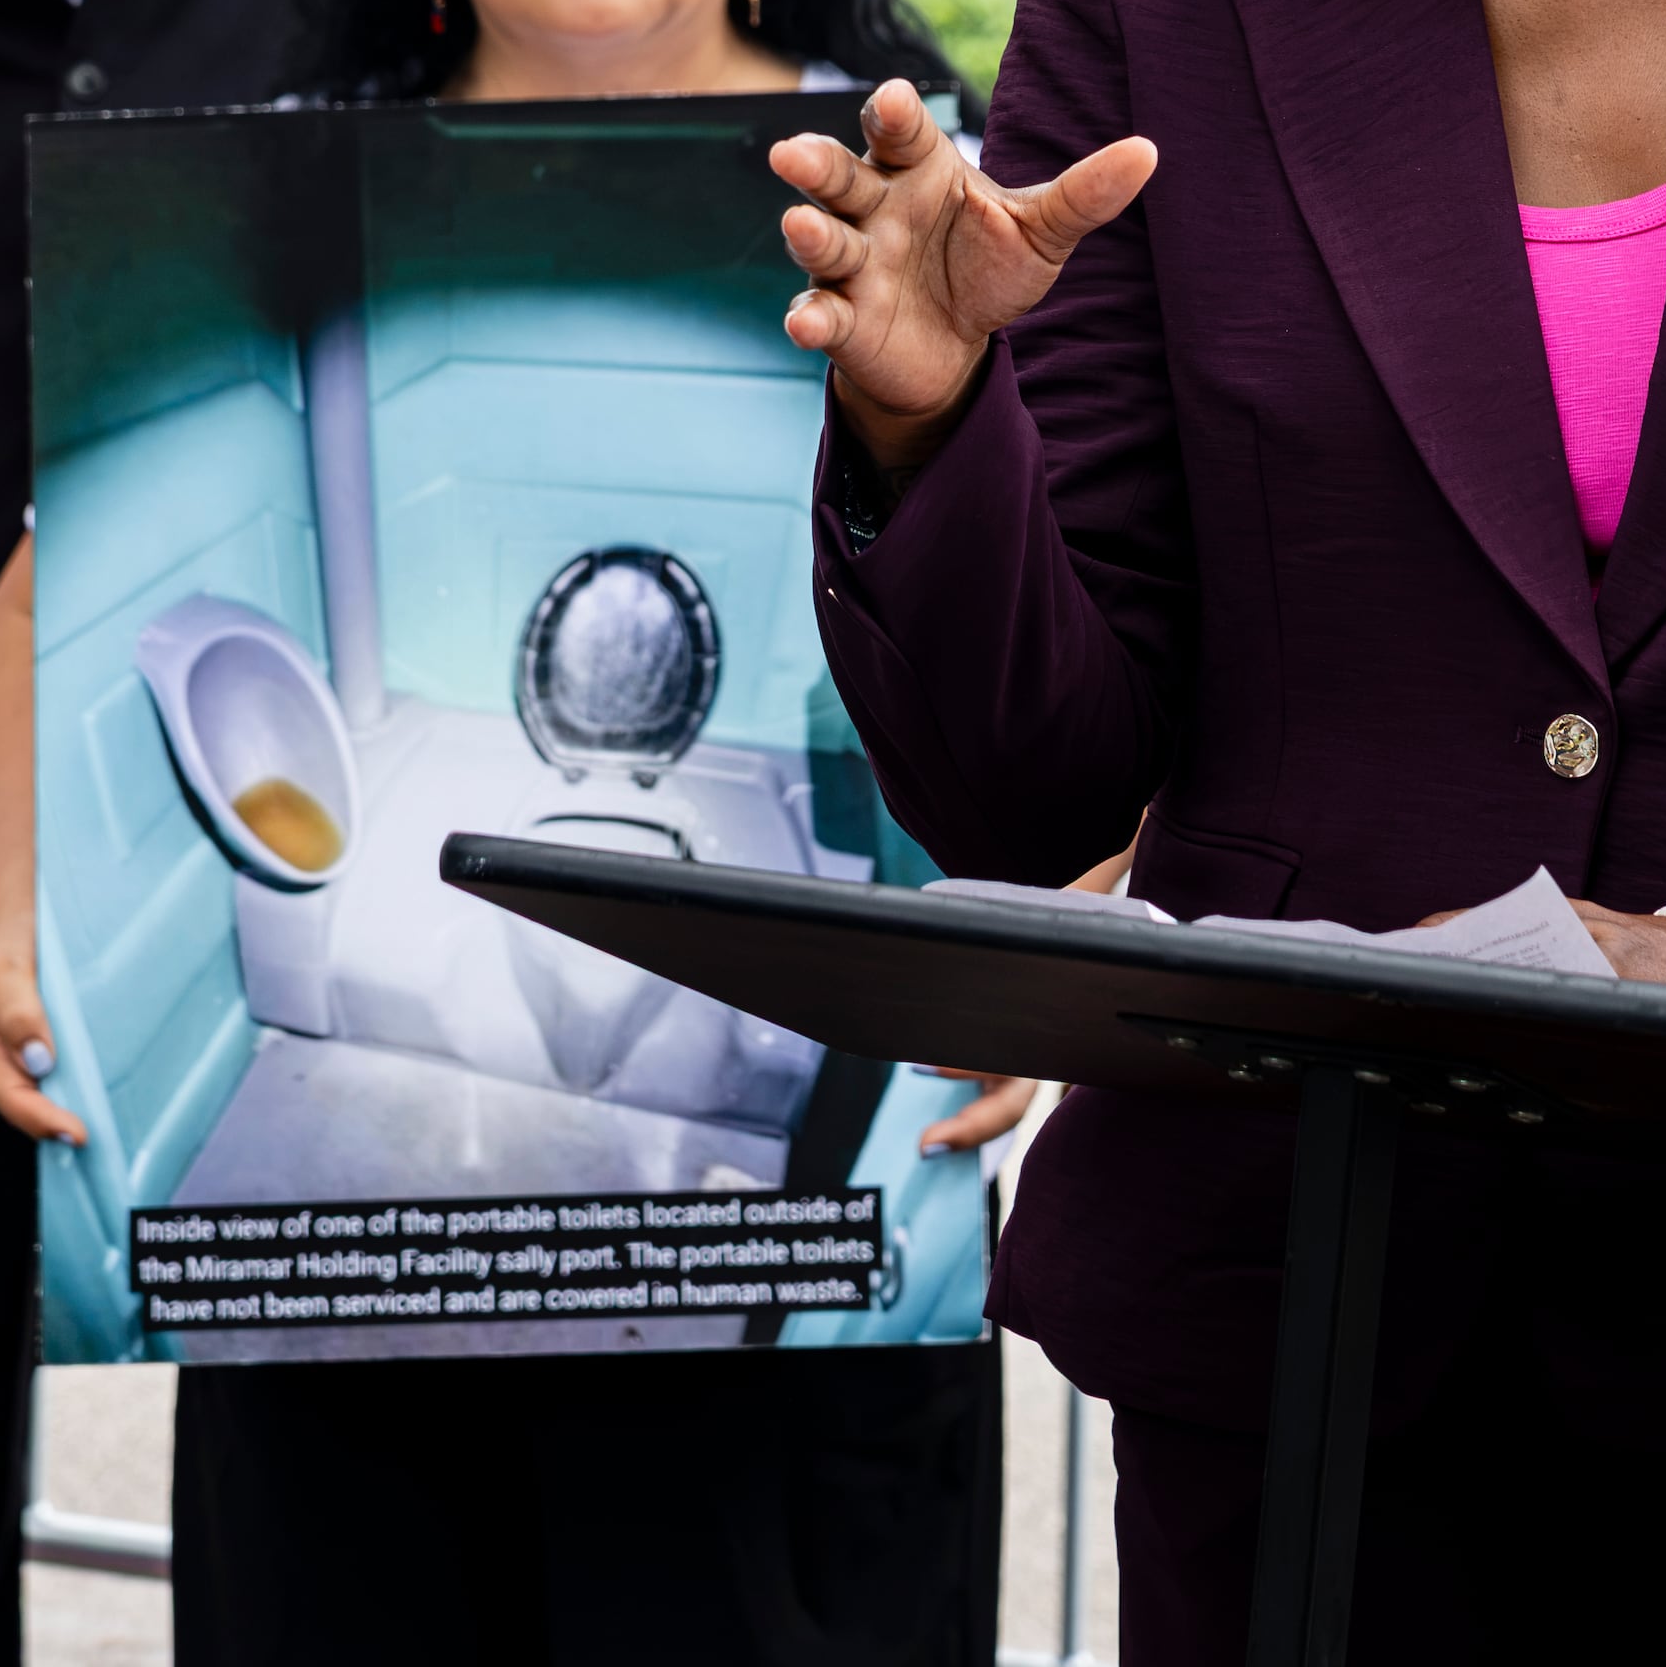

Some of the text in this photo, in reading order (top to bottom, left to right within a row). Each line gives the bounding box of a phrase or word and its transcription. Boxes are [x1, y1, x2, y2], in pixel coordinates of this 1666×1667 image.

[137, 1194, 875, 1242] Inside view of one of the portable toilets located outside of
[138, 1236, 875, 1283] the Miramar Holding Facility sally port. The portable toilets
[150, 1278, 863, 1321] have not been serviced and are covered in human waste.
